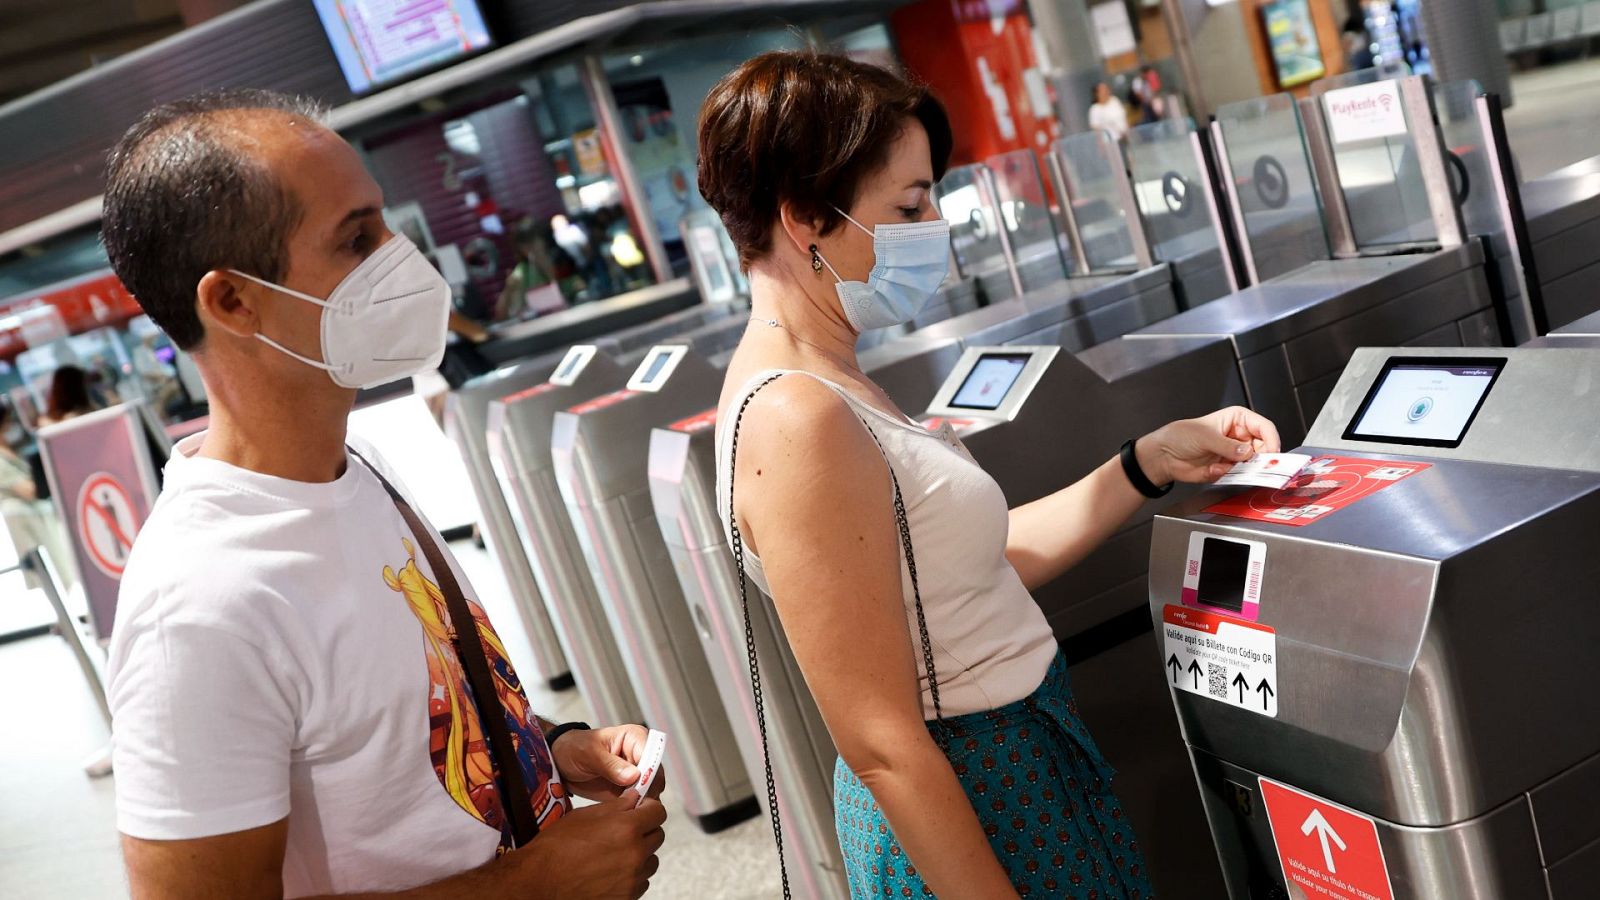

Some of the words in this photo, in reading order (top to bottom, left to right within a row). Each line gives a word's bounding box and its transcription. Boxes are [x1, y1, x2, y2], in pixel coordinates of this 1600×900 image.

[1166, 628, 1184, 641] Valide
[1198, 638, 1205, 647] su
[1206, 638, 1226, 652] Billete
[1227, 645, 1238, 655] con
[1262, 653, 1272, 664] QR
[1287, 857, 1306, 872] Valide
[1321, 873, 1330, 883] su
[1347, 883, 1357, 895] de
[1292, 872, 1314, 888] Validate
[1315, 884, 1328, 894] your
